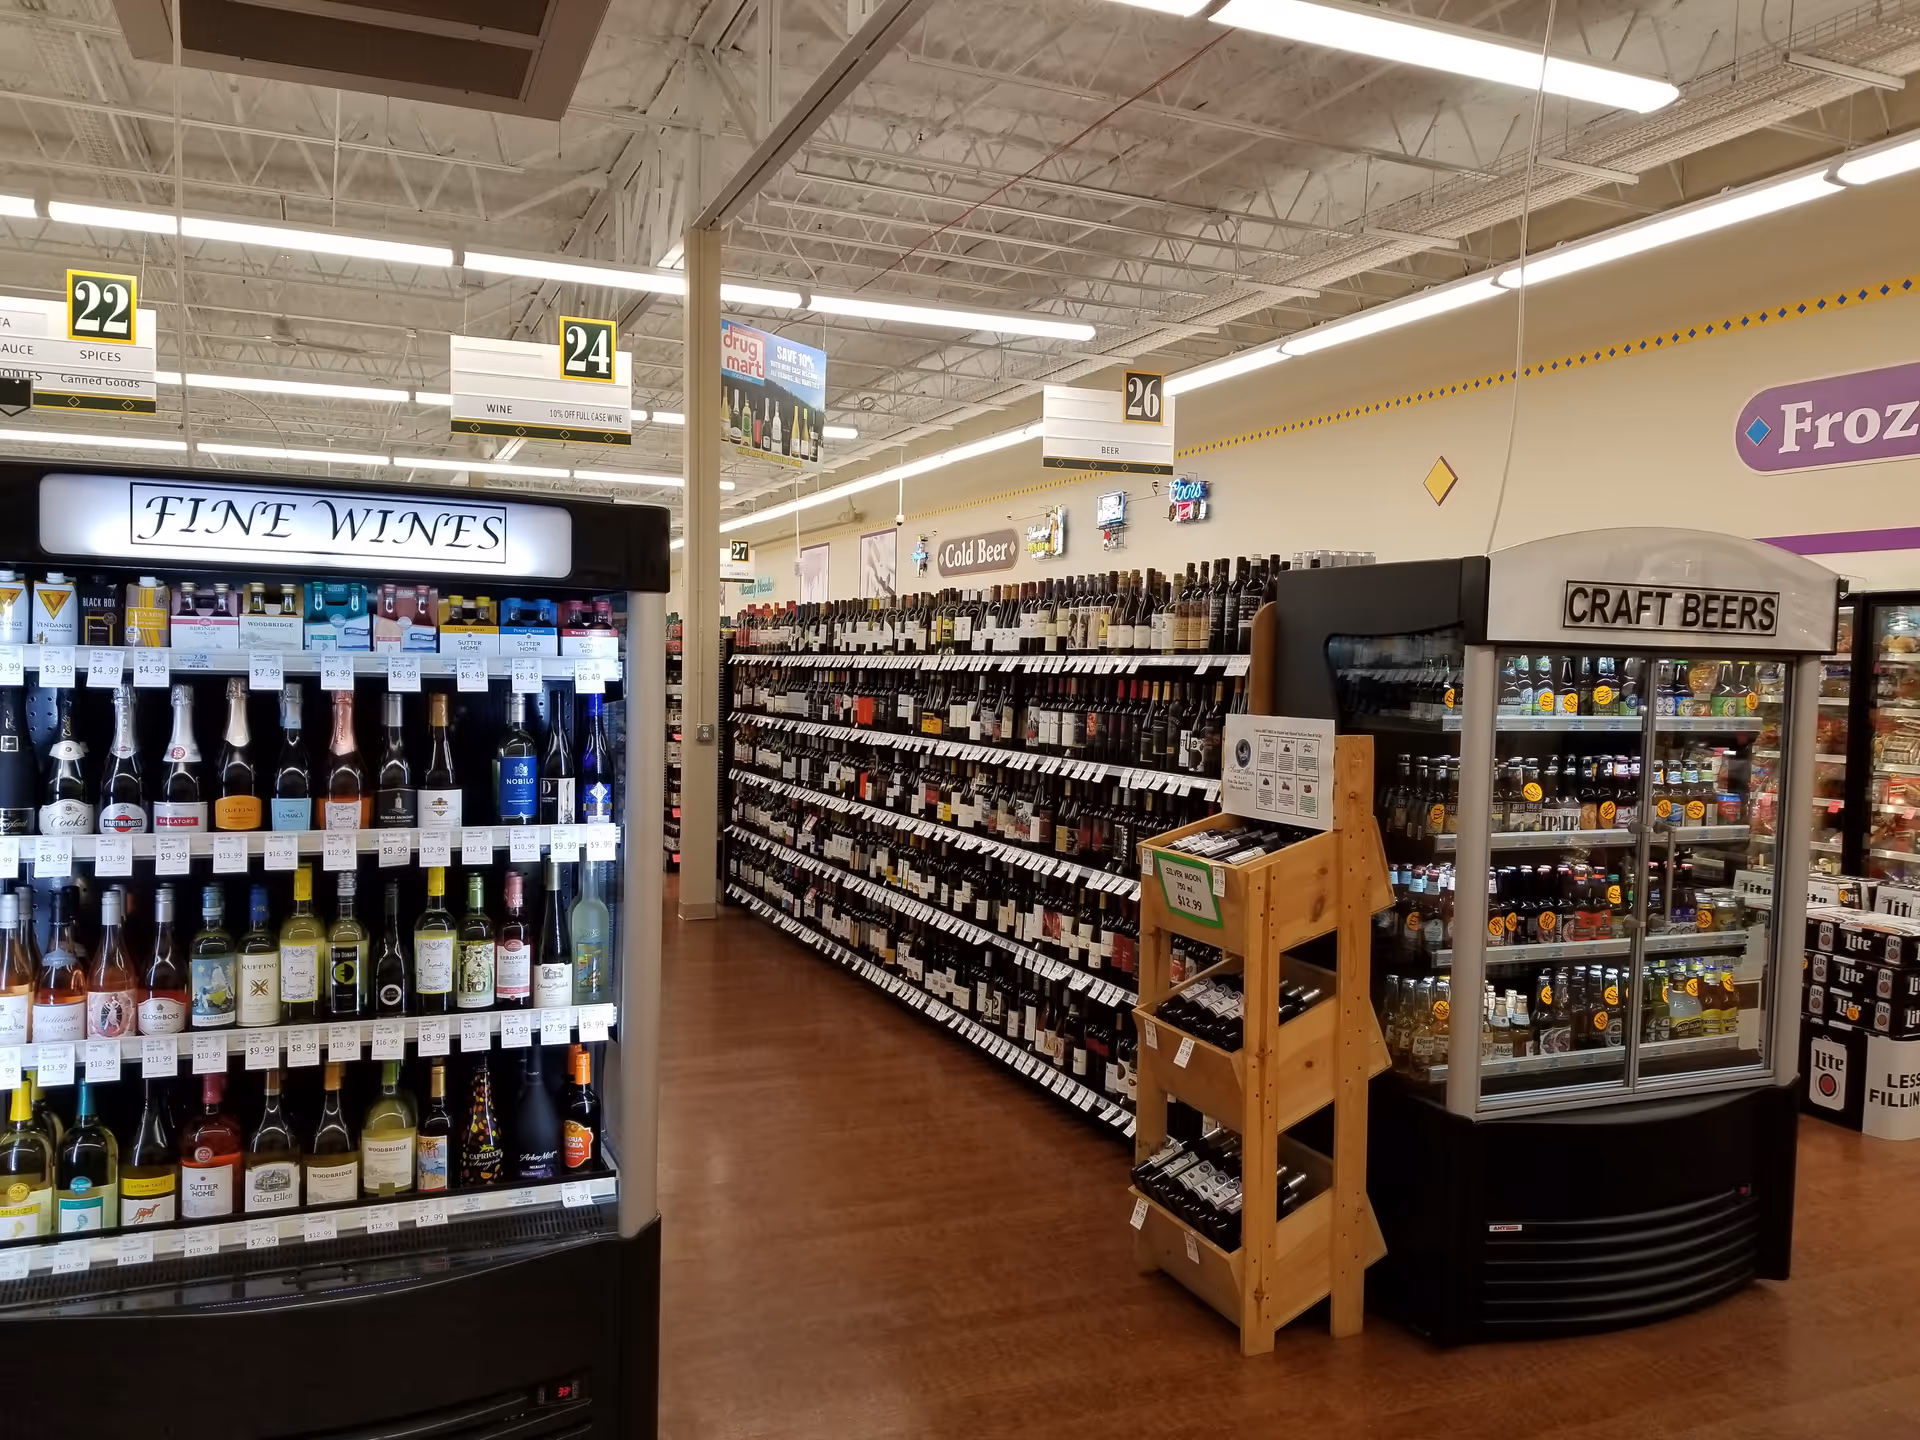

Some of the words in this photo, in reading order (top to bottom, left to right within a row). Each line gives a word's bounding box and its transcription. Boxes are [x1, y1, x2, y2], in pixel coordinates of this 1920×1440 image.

[74, 280, 129, 334] 22
[723, 324, 758, 361] drug
[566, 325, 610, 374] 24
[79, 349, 122, 362] SPICES
[776, 345, 797, 364] SAVE
[798, 352, 815, 369] 10%
[726, 355, 765, 378] mart
[0, 368, 43, 381] OODLES
[60, 373, 102, 385] Canned
[105, 379, 140, 389] Goods
[1127, 377, 1160, 418] 26
[486, 403, 513, 414] WINE
[549, 409, 564, 419] 10%
[564, 410, 576, 420] OFF
[576, 411, 590, 421] FULL
[591, 412, 606, 422] CASE
[607, 413, 623, 424] WINE
[1778, 400, 1920, 454] Froz
[1101, 446, 1120, 455] BEER
[1169, 479, 1202, 502] Coors
[137, 493, 298, 541] FINE
[313, 500, 503, 552] WINES
[732, 542, 748, 560] 27
[944, 544, 974, 569] Cold
[977, 539, 1008, 563] Beer
[83, 597, 102, 607] BLACK
[103, 598, 116, 607] BOX
[1568, 586, 1673, 626] CRAFT
[1681, 592, 1776, 631] BEERS
[36, 621, 73, 629] VENDANGE
[45, 665, 73, 674] $3.99
[92, 666, 120, 675] $4.99
[138, 665, 166, 674] $4.99
[254, 668, 280, 677] $7.99
[325, 669, 351, 677] $6.99
[392, 671, 417, 679] $6.99
[461, 671, 485, 679] $6.49
[515, 672, 539, 680] $6.49
[578, 673, 601, 681] $6.49
[48, 813, 89, 828] Cook's
[554, 842, 577, 850] $9.99
[590, 841, 613, 849] $9.99
[383, 846, 408, 855] $8.99
[423, 846, 445, 854] $12.99
[40, 854, 69, 862] $8.99
[160, 852, 187, 861] $9.99
[1166, 867, 1183, 878] SILVER
[1185, 873, 1202, 883] MOON
[1177, 894, 1202, 911] $12.99
[1820, 924, 1833, 933] Lite
[1845, 933, 1872, 951] Lite
[1887, 938, 1900, 947] Lite
[1814, 957, 1826, 965] Lite
[1839, 966, 1864, 984] Lite
[1879, 971, 1892, 980] Lite
[1811, 988, 1823, 996] Lite
[1877, 1003, 1890, 1013] Lite
[544, 1024, 567, 1032] $7.99
[583, 1020, 605, 1028] $9.99
[505, 1027, 529, 1035] $4.99
[422, 1033, 446, 1042] $8.99
[249, 1046, 275, 1055] $9.99
[291, 1043, 317, 1052] $8.99
[90, 1060, 115, 1068] $10.99
[1814, 1049, 1844, 1072] Lite
[42, 1063, 68, 1072] $13.99
[519, 1153, 540, 1163] Arbor
[540, 1151, 555, 1159] Mist
[312, 1169, 353, 1178] WOODBRIDGE
[253, 1194, 272, 1203] Glen
[274, 1193, 293, 1202] Ellen
[567, 1194, 589, 1202] $5.99
[419, 1213, 444, 1222] $7.99
[371, 1221, 394, 1229] $12.99
[308, 1230, 332, 1238] $12.99
[251, 1236, 276, 1246] $7.99
[189, 1245, 213, 1254] $10.99
[122, 1254, 148, 1263] $11.99
[58, 1262, 84, 1270] $10.99
